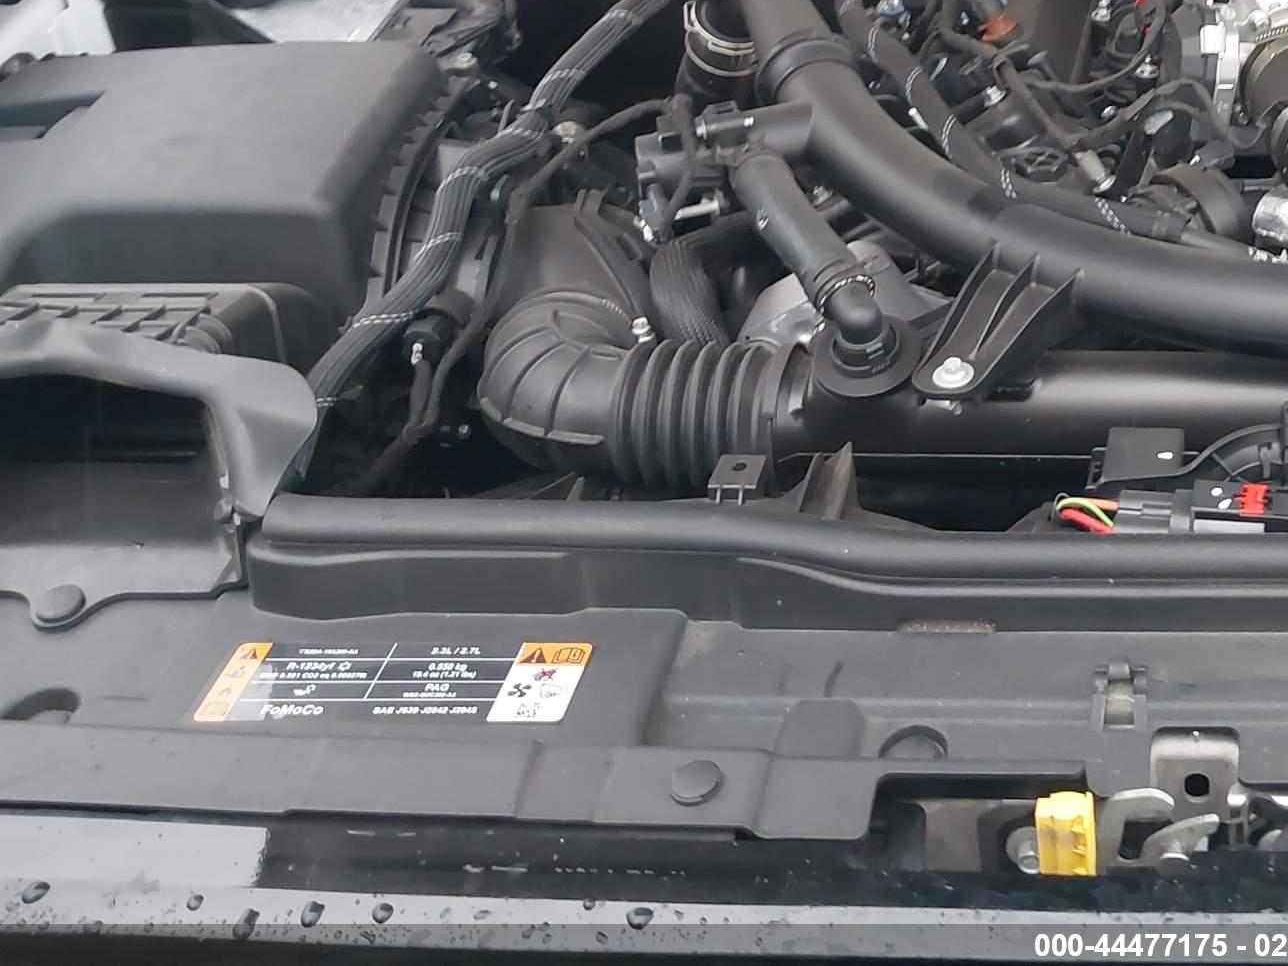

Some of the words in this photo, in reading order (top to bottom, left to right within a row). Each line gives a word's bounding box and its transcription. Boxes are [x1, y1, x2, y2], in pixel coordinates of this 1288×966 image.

[286, 661, 336, 671] R-1234yf
[424, 683, 450, 692] PAG
[260, 704, 324, 715] FoMoCo
